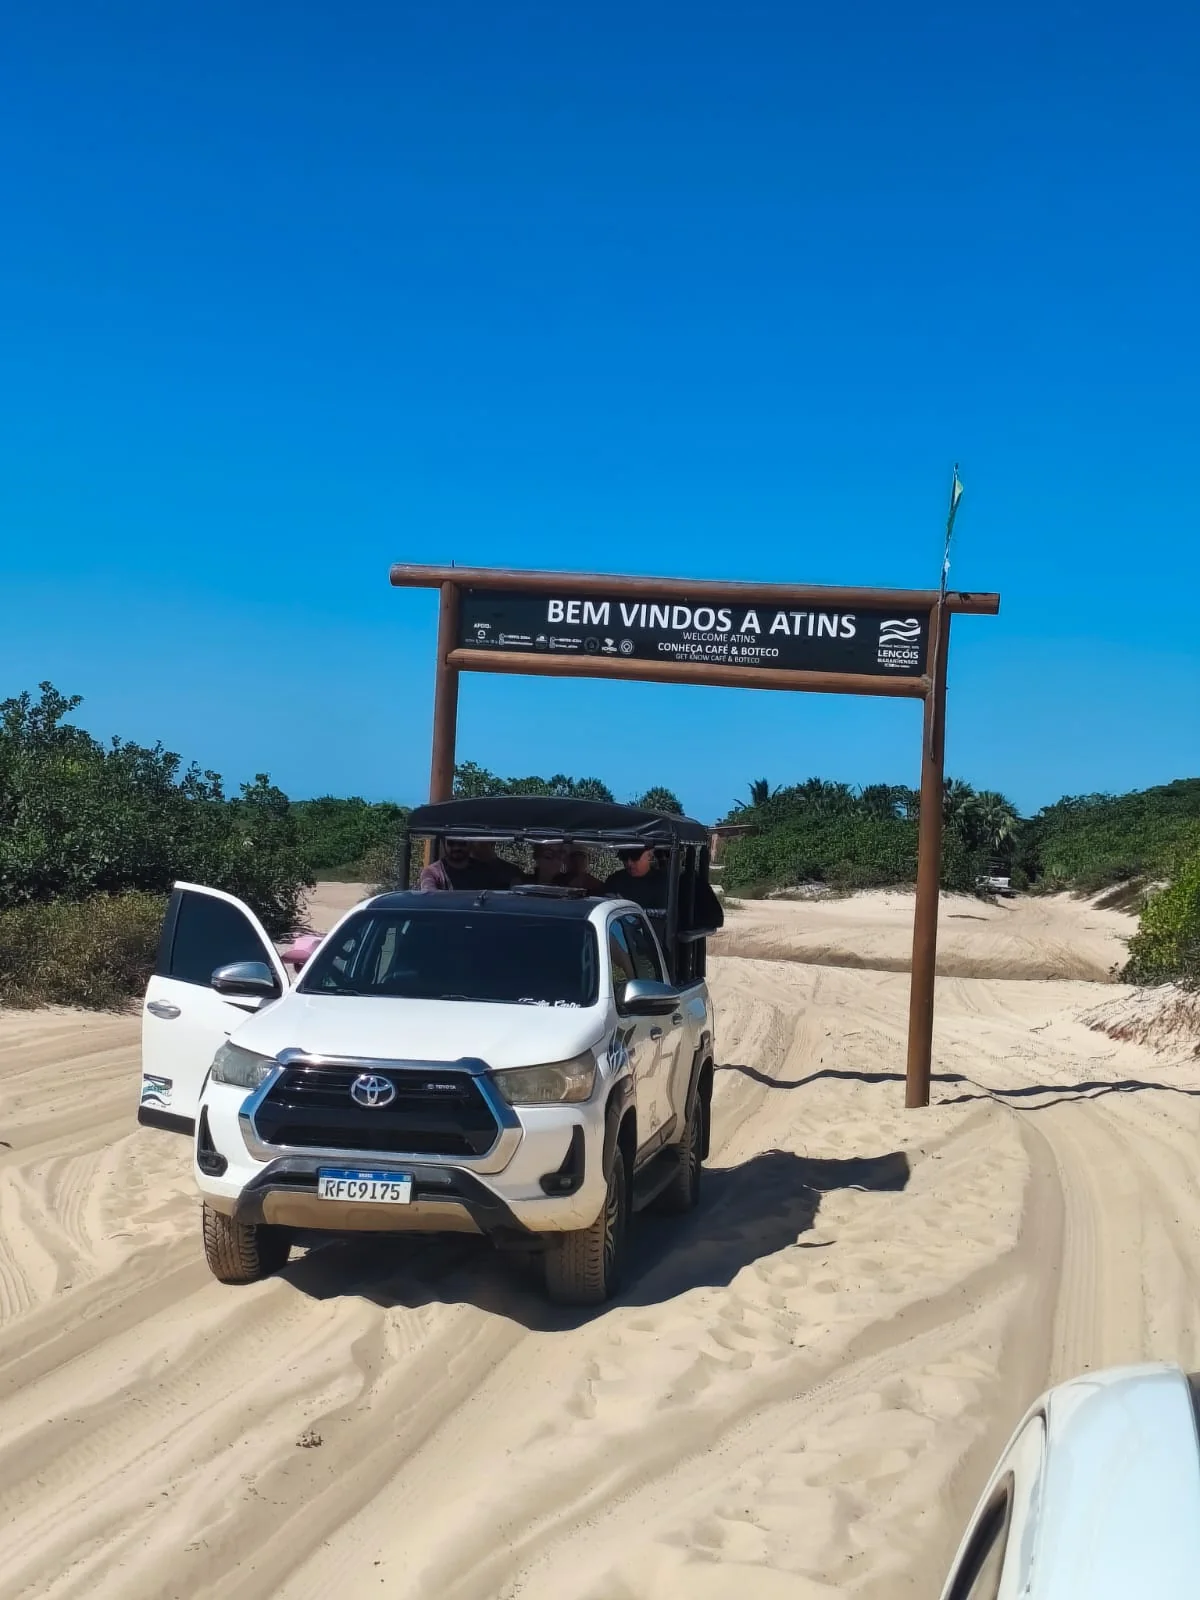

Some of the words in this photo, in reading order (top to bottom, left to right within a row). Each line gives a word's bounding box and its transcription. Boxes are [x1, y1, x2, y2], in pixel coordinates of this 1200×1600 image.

[548, 599, 610, 625] BEM
[619, 603, 732, 632] VINDOS
[740, 609, 761, 634] A
[769, 611, 856, 638] ATINS
[682, 631, 728, 643] WELCOME
[730, 634, 756, 644] ATINS
[658, 642, 703, 655] CONHEÇA
[705, 644, 728, 655] CAFÉ
[731, 647, 738, 655] &
[741, 647, 779, 657] BOTECO
[734, 656, 760, 664] BOTECO
[324, 1180, 401, 1201] RFC9175
